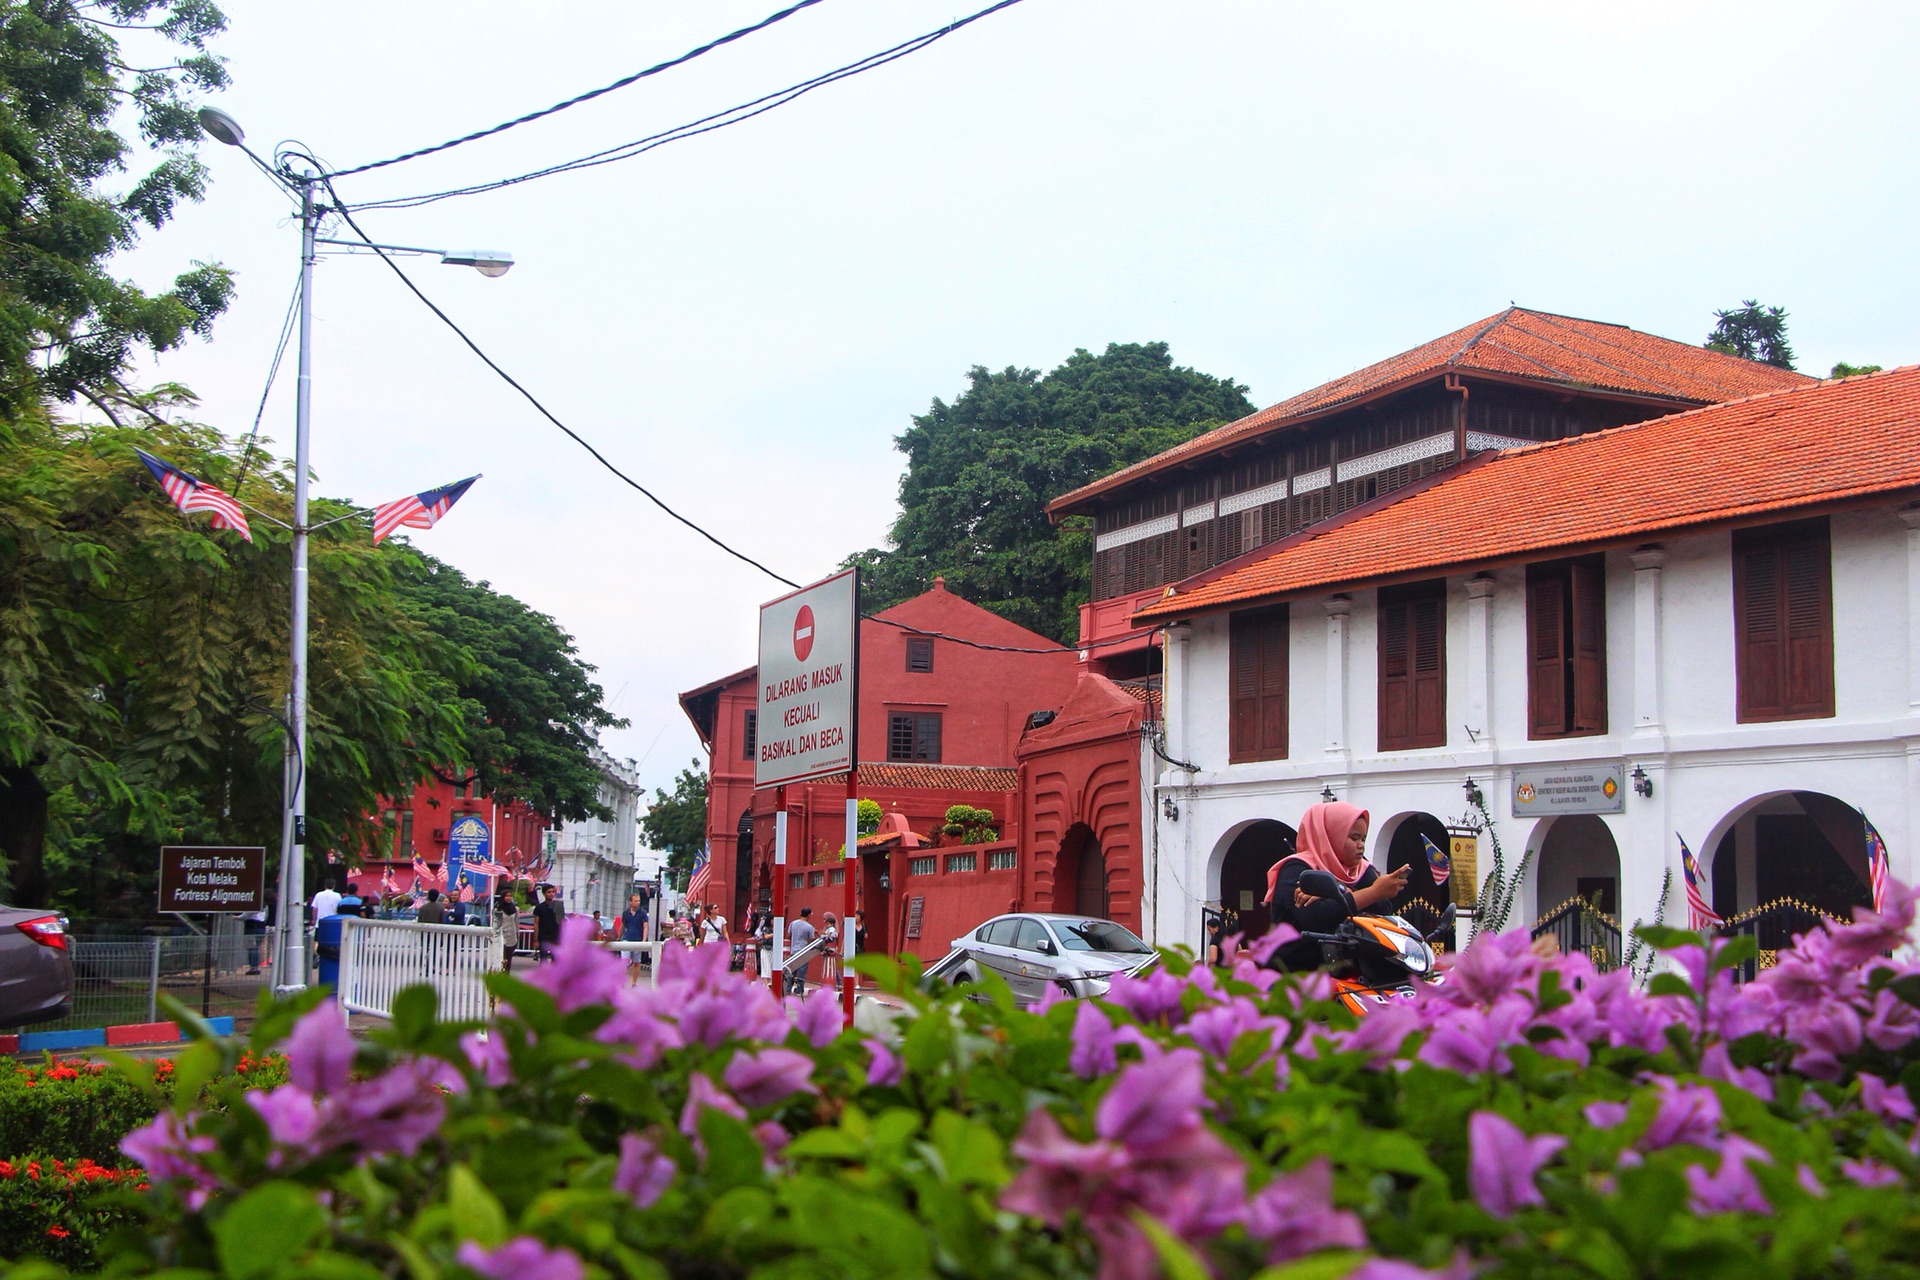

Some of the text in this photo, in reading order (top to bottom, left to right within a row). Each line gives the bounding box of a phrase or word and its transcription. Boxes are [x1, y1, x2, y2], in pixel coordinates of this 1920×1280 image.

[766, 663, 843, 703] DILARANG MASUK
[784, 701, 820, 728] KECUALI
[761, 726, 844, 762] BASIKAL DAN BECA
[181, 856, 246, 871] Jajaran Tembok
[187, 872, 238, 885] Kota Melaka
[174, 888, 254, 903] Fortress Alignment
